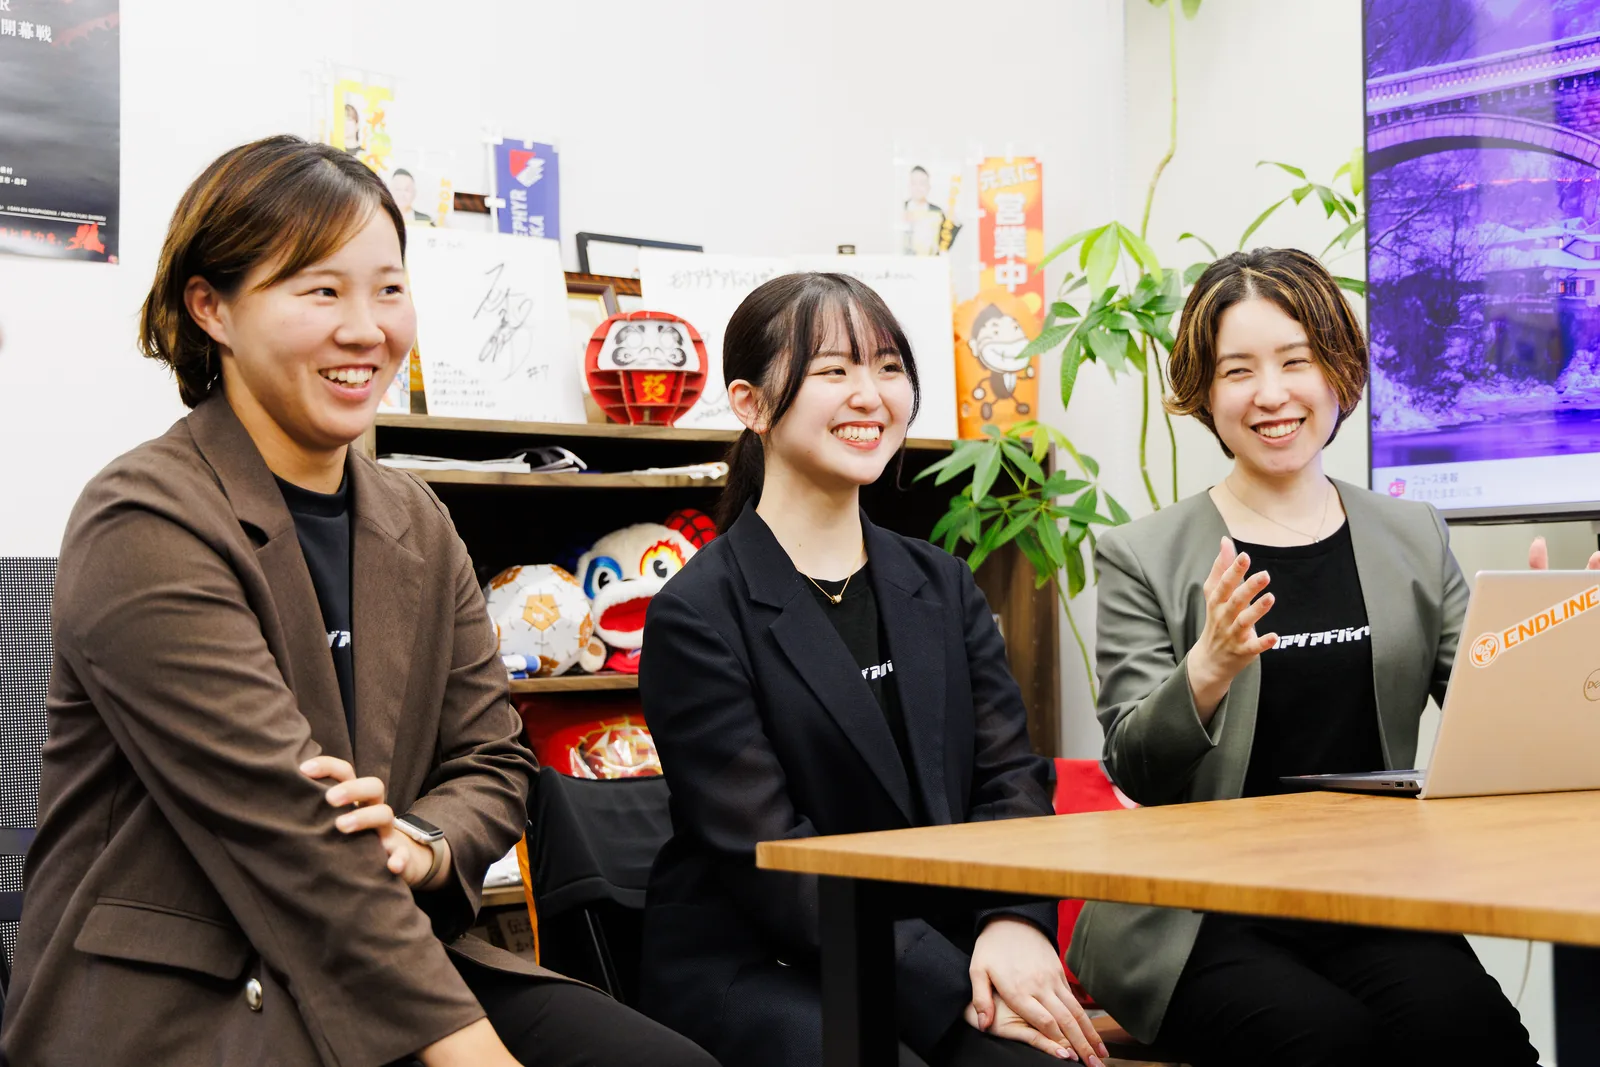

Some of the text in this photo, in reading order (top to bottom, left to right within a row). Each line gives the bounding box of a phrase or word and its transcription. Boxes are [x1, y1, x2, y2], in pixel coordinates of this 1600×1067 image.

[1, 18, 52, 43] 開幕戦
[981, 162, 1037, 191] 元気に
[994, 192, 1027, 293] 営業中
